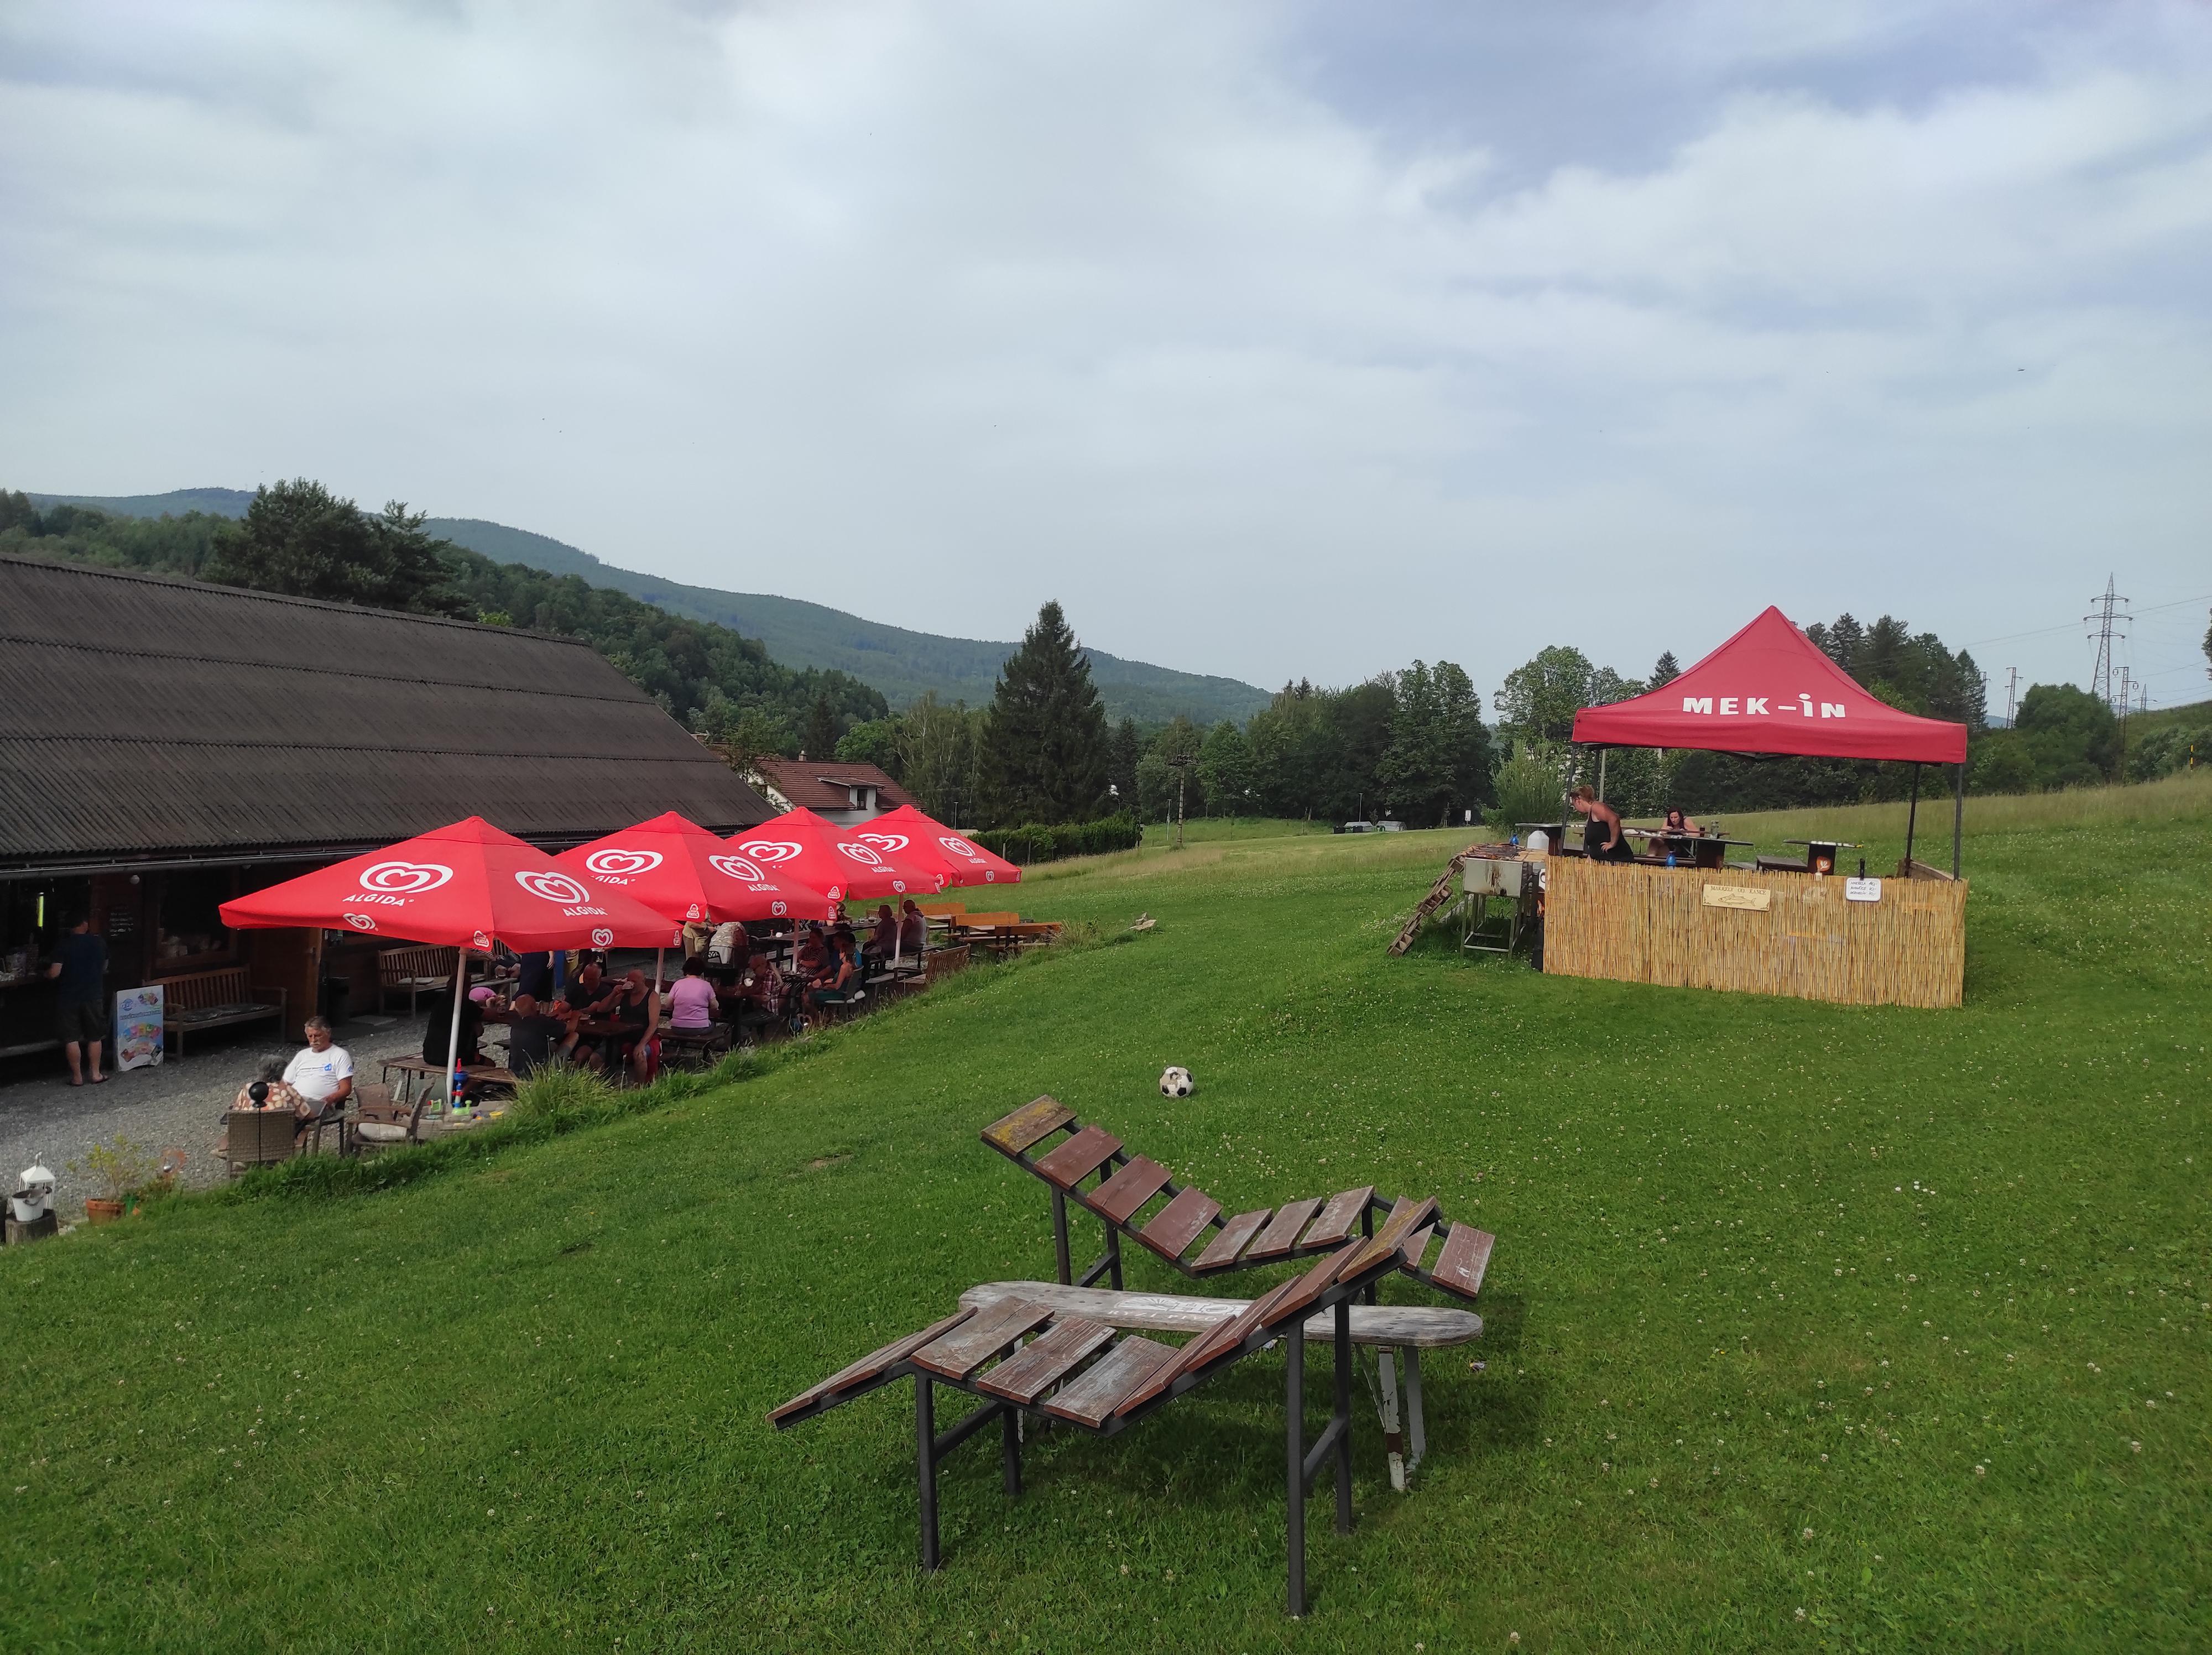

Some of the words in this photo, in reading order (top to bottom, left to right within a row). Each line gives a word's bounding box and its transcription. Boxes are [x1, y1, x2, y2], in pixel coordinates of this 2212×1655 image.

[590, 875, 628, 885] GIDA
[747, 884, 781, 892] ALGIDA
[342, 894, 406, 906] ALGIDA
[562, 906, 608, 916] ALGIDA
